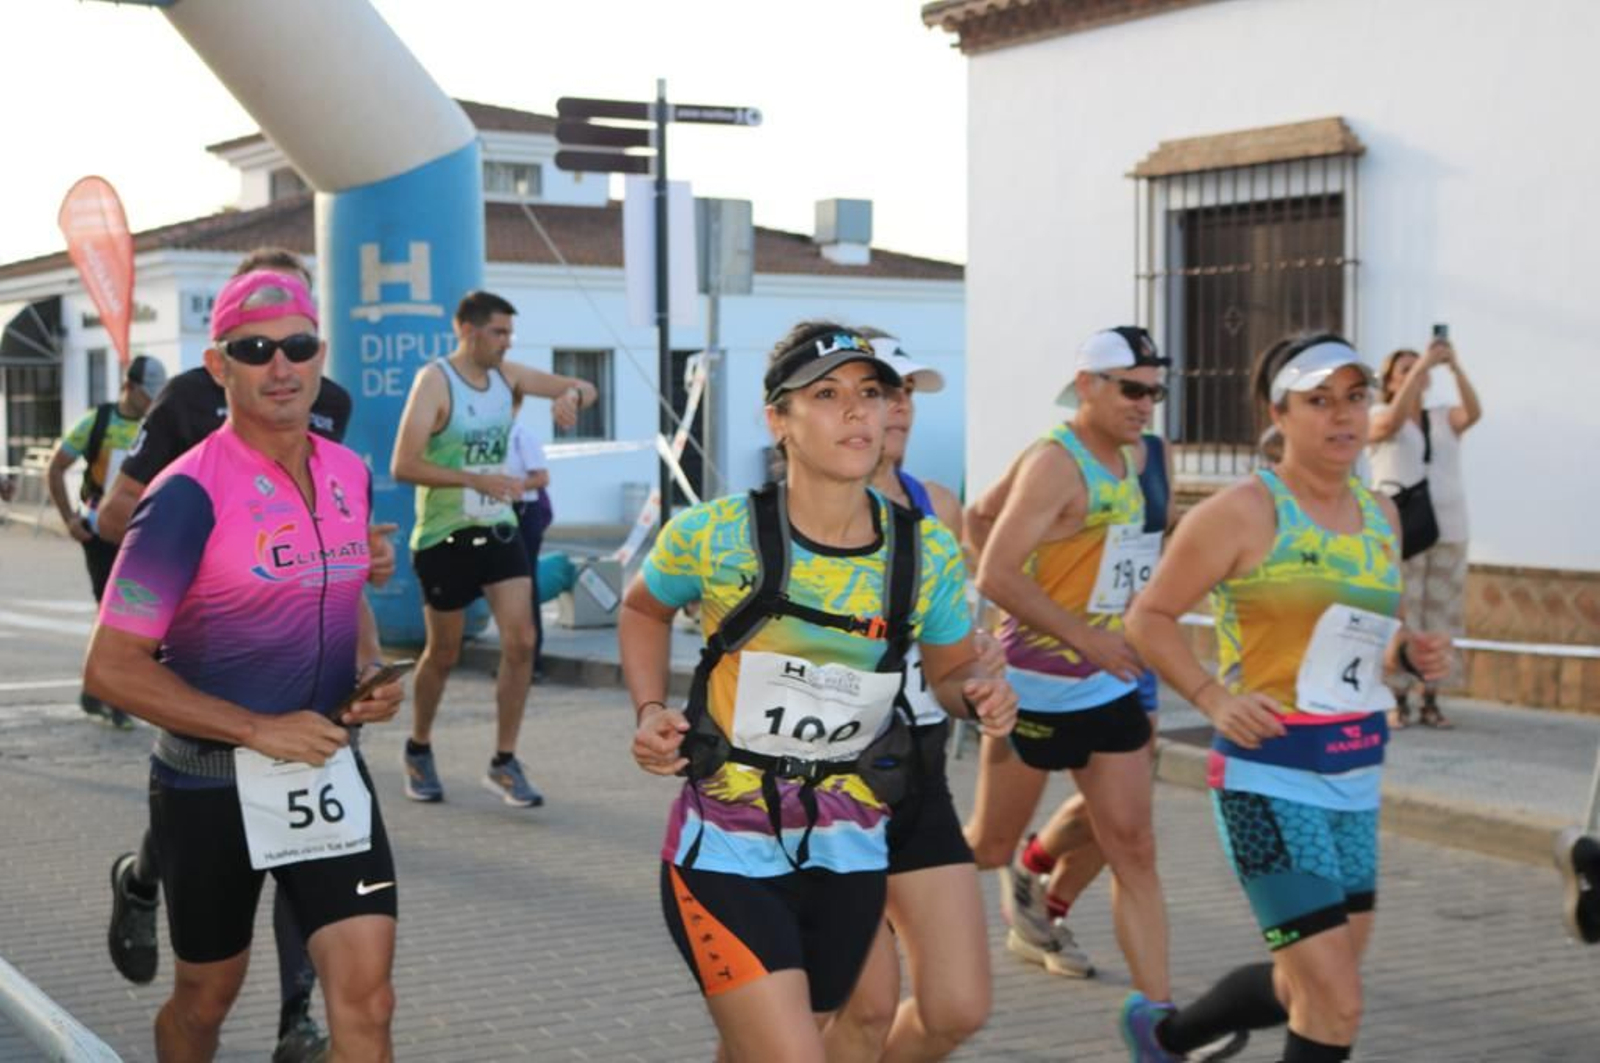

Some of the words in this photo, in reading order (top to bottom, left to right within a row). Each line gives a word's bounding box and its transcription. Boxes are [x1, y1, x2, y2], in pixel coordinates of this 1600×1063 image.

[360, 241, 431, 302] H
[363, 369, 405, 397] DE
[1342, 657, 1362, 692] 4
[287, 783, 346, 829] 56
